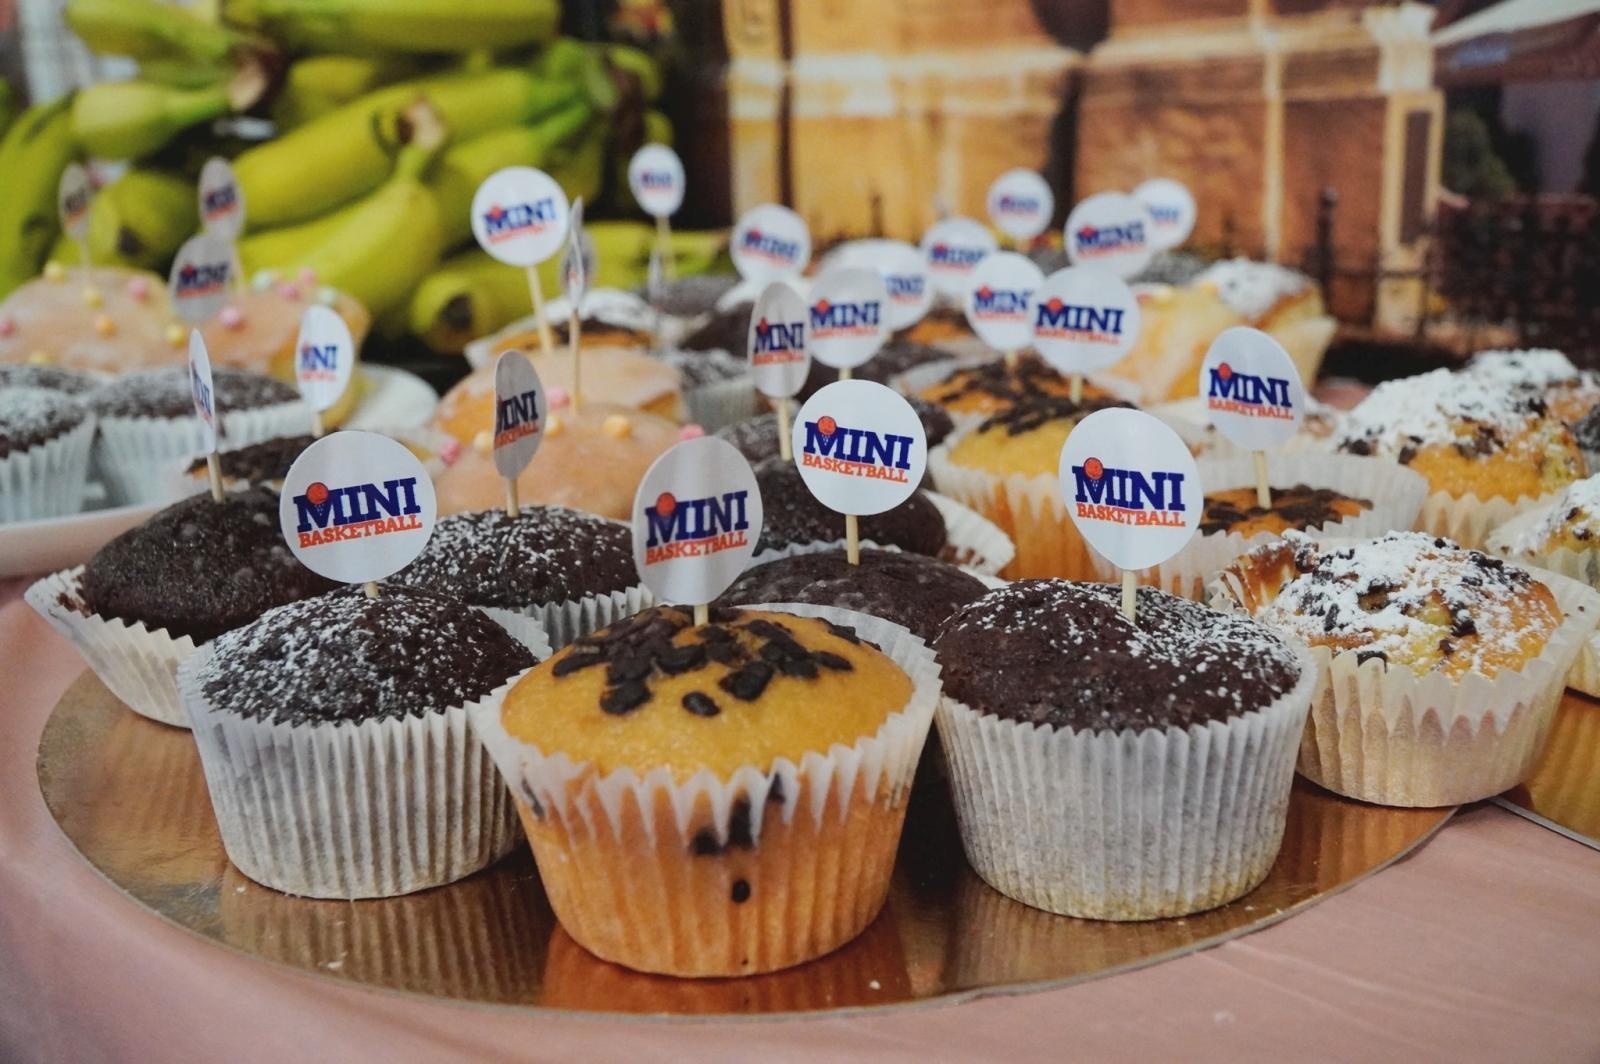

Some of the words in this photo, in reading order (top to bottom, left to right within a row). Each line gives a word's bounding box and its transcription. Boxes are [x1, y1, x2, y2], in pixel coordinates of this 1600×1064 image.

[810, 302, 879, 330] MINI
[1037, 303, 1124, 335] MINI
[754, 322, 804, 354] MINI
[1208, 366, 1292, 408] MINI
[1208, 396, 1294, 420] BASKETBALL
[804, 417, 914, 470] MINI
[802, 452, 908, 483] BASKETBALL
[1072, 463, 1186, 511] MINI
[293, 477, 421, 533] MINI
[645, 490, 749, 548] MINI
[1077, 502, 1186, 527] BASKETBALL
[298, 514, 423, 548] BASKETBALL
[645, 531, 748, 565] BASKETBALL
